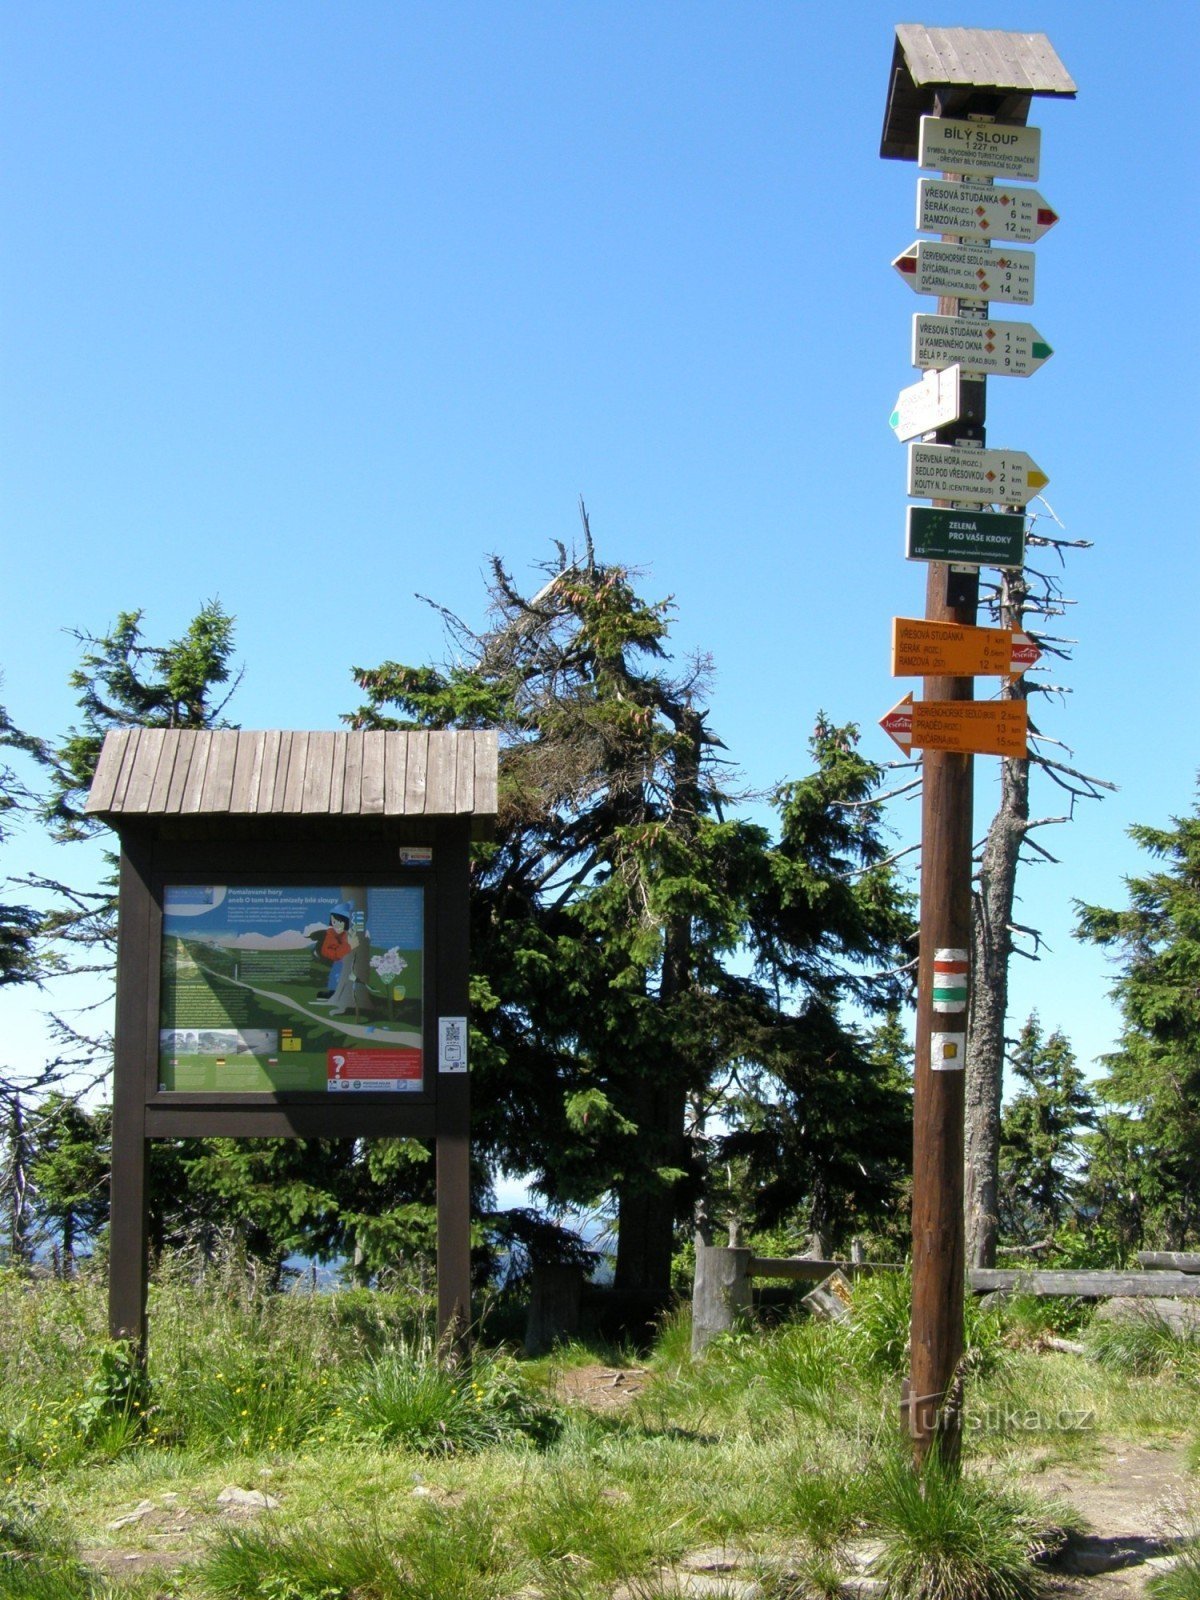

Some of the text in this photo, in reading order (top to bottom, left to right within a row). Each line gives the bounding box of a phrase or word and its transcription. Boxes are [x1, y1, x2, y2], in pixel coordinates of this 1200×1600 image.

[944, 127, 1018, 145] BÍLÝ SLOUP
[973, 143, 987, 151] 227
[976, 159, 1005, 168] ORIENTAČNÍ
[978, 152, 1012, 162] TURISTICKÉHO
[1013, 155, 1035, 164] ZNAČENÍ
[925, 188, 959, 200] VŘESOVÁ
[960, 191, 999, 204] STUDÁNKA
[1011, 197, 1016, 206] 1
[924, 201, 948, 211] ŠERÁK
[1011, 210, 1016, 219] 6
[924, 213, 959, 226] RAMZOVÁ
[1004, 223, 1016, 232] 12
[1020, 226, 1031, 234] km
[922, 250, 966, 264] ČERVENOHORSKÉ
[967, 256, 984, 266] SEDLO
[922, 274, 945, 286] OVČÁRNA
[1000, 285, 1011, 293] 14
[1018, 288, 1029, 296] km
[1005, 272, 1012, 281] 9
[1018, 275, 1029, 283] km
[920, 323, 949, 336] VŘESOVÁ
[950, 326, 983, 338] STUDÁNKA
[1005, 333, 1010, 341] 1
[919, 337, 924, 346] U
[925, 338, 964, 350] KAMENNÉHO
[965, 341, 982, 351] OKNA
[1005, 345, 1011, 354] 2
[919, 349, 935, 360] BĚLÁ
[1005, 357, 1011, 366] 9
[915, 452, 943, 464] ČERVENÁ
[943, 456, 960, 466] HORA
[1001, 461, 1006, 470] 1
[915, 466, 1022, 484] SEDLO POD VŘESOVKOU 2 km
[914, 479, 934, 490] KOUTY
[1000, 486, 1006, 495] 9
[1011, 489, 1022, 497] km
[949, 521, 977, 530] ZELENÁ
[949, 532, 1012, 544] PRO VAŠE KROKY
[900, 628, 929, 640] VŘESOVÁ
[930, 630, 964, 641] STUDÁNKA
[900, 641, 920, 653] ŠERÁK
[899, 655, 929, 667] RAMZOVÁ
[980, 660, 989, 670] 12
[997, 724, 1006, 733] 13
[916, 732, 946, 743] OVČÁRNA
[268, 889, 282, 897] hory
[280, 896, 304, 904] zmizely
[317, 897, 339, 905] sloupy
